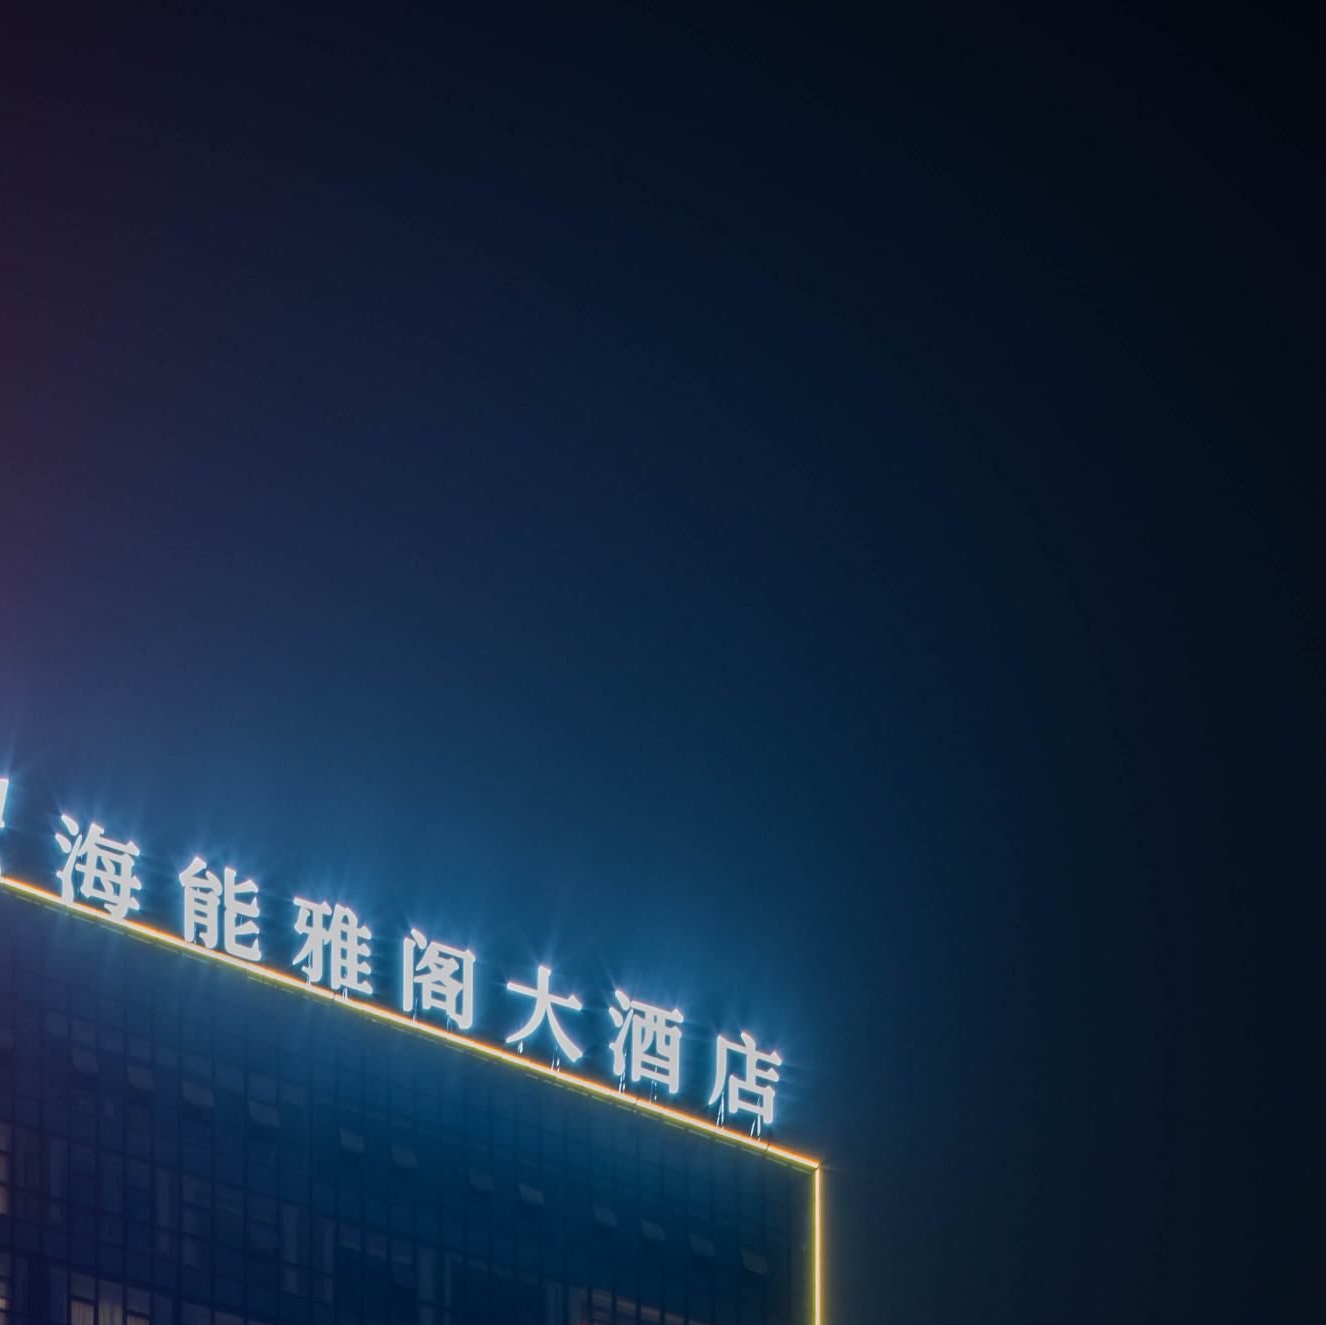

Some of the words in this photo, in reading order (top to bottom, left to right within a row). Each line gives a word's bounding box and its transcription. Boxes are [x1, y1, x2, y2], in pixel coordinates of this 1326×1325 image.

[55, 814, 784, 1125] 海能雅阁大酒店
